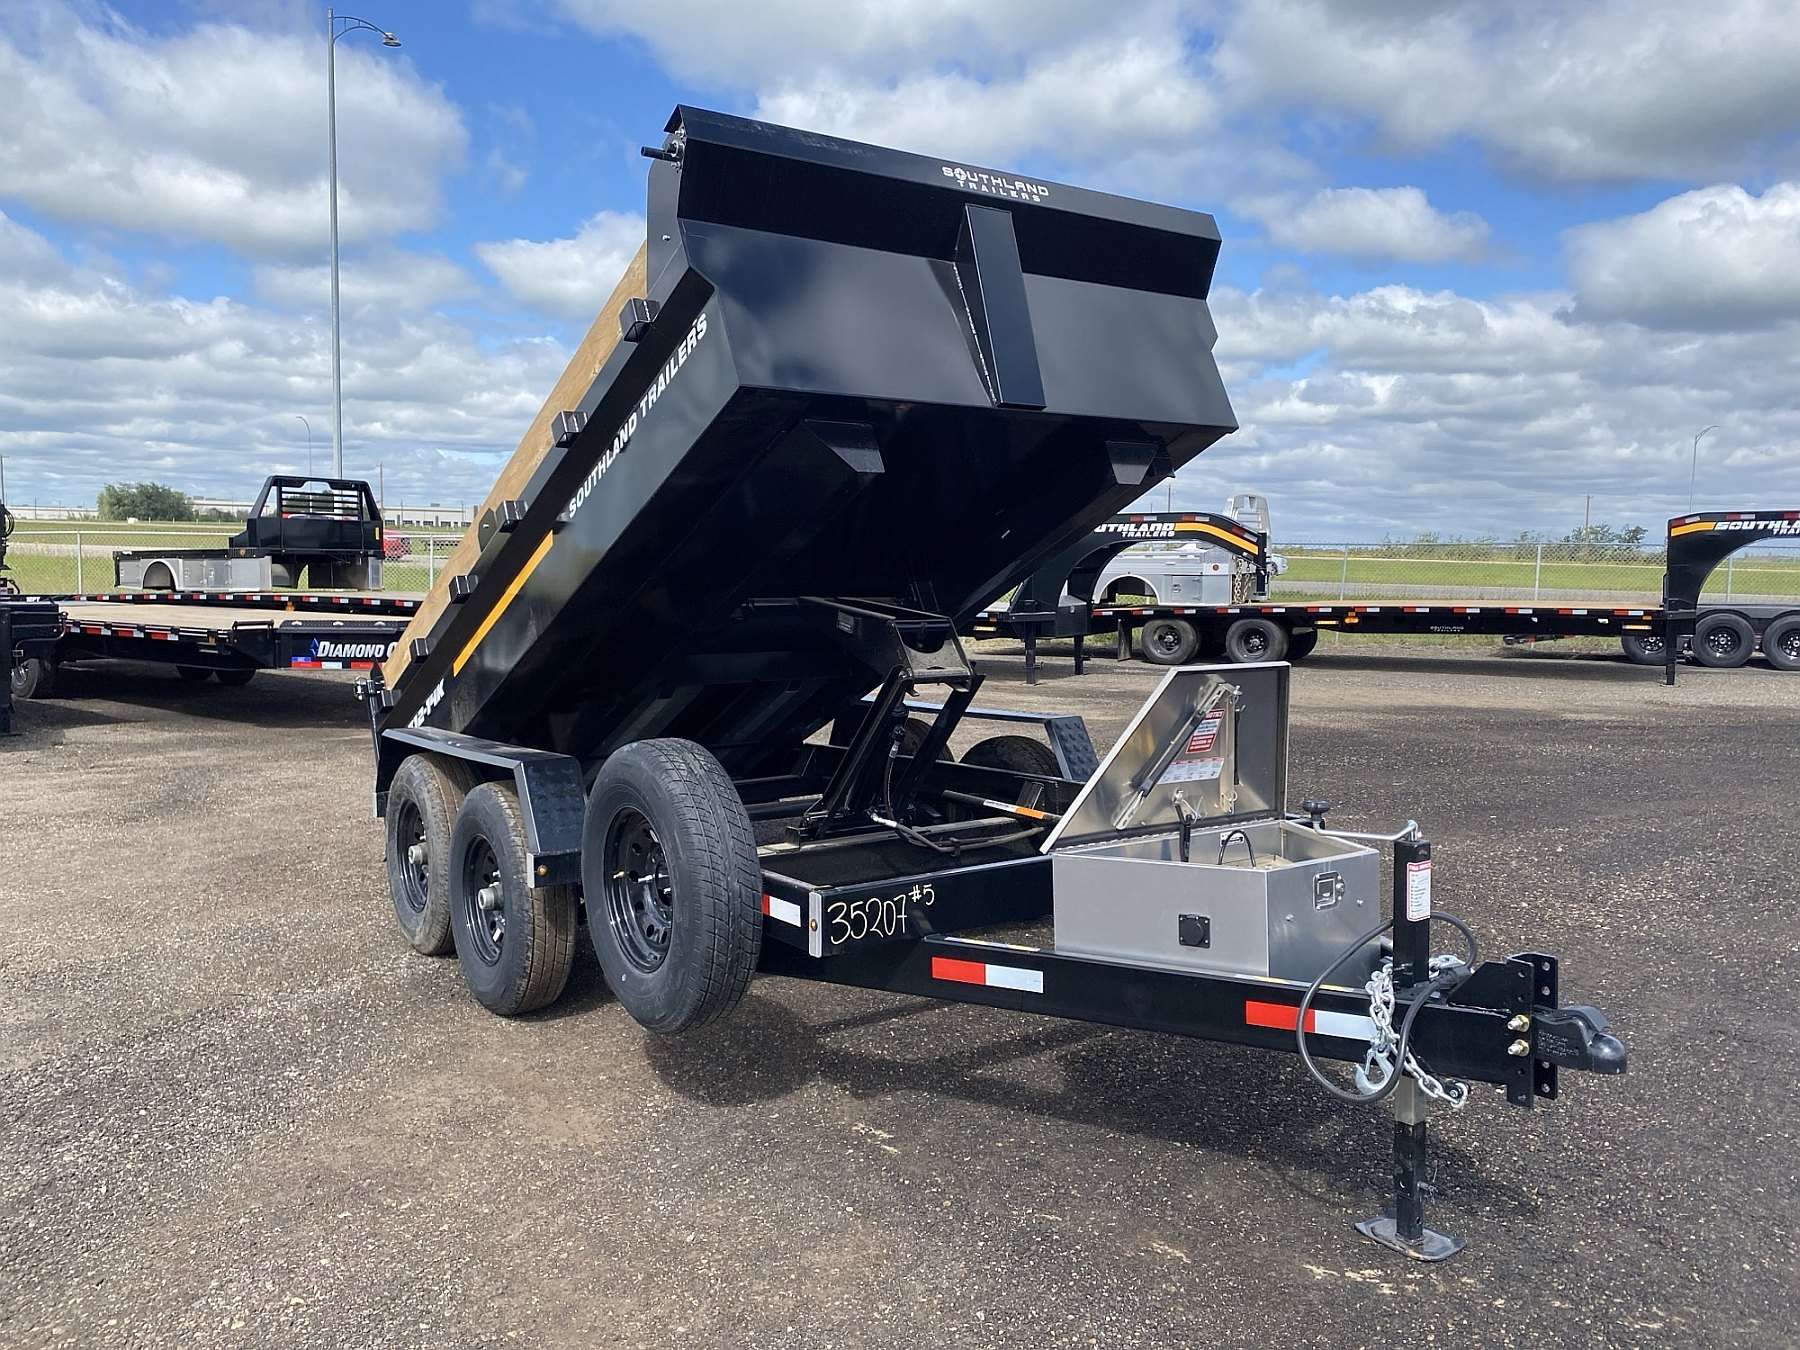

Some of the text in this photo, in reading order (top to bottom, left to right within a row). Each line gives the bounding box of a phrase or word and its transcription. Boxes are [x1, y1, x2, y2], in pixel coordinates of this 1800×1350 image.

[942, 166, 1049, 195] SOUTHLAND
[957, 180, 1041, 202] TRAILERS
[569, 312, 707, 519] SOUTHLAND TRAILERS
[1093, 523, 1176, 532] UTHLAND
[316, 641, 384, 658] DIAMOND
[827, 883, 935, 944] 35207 #5
